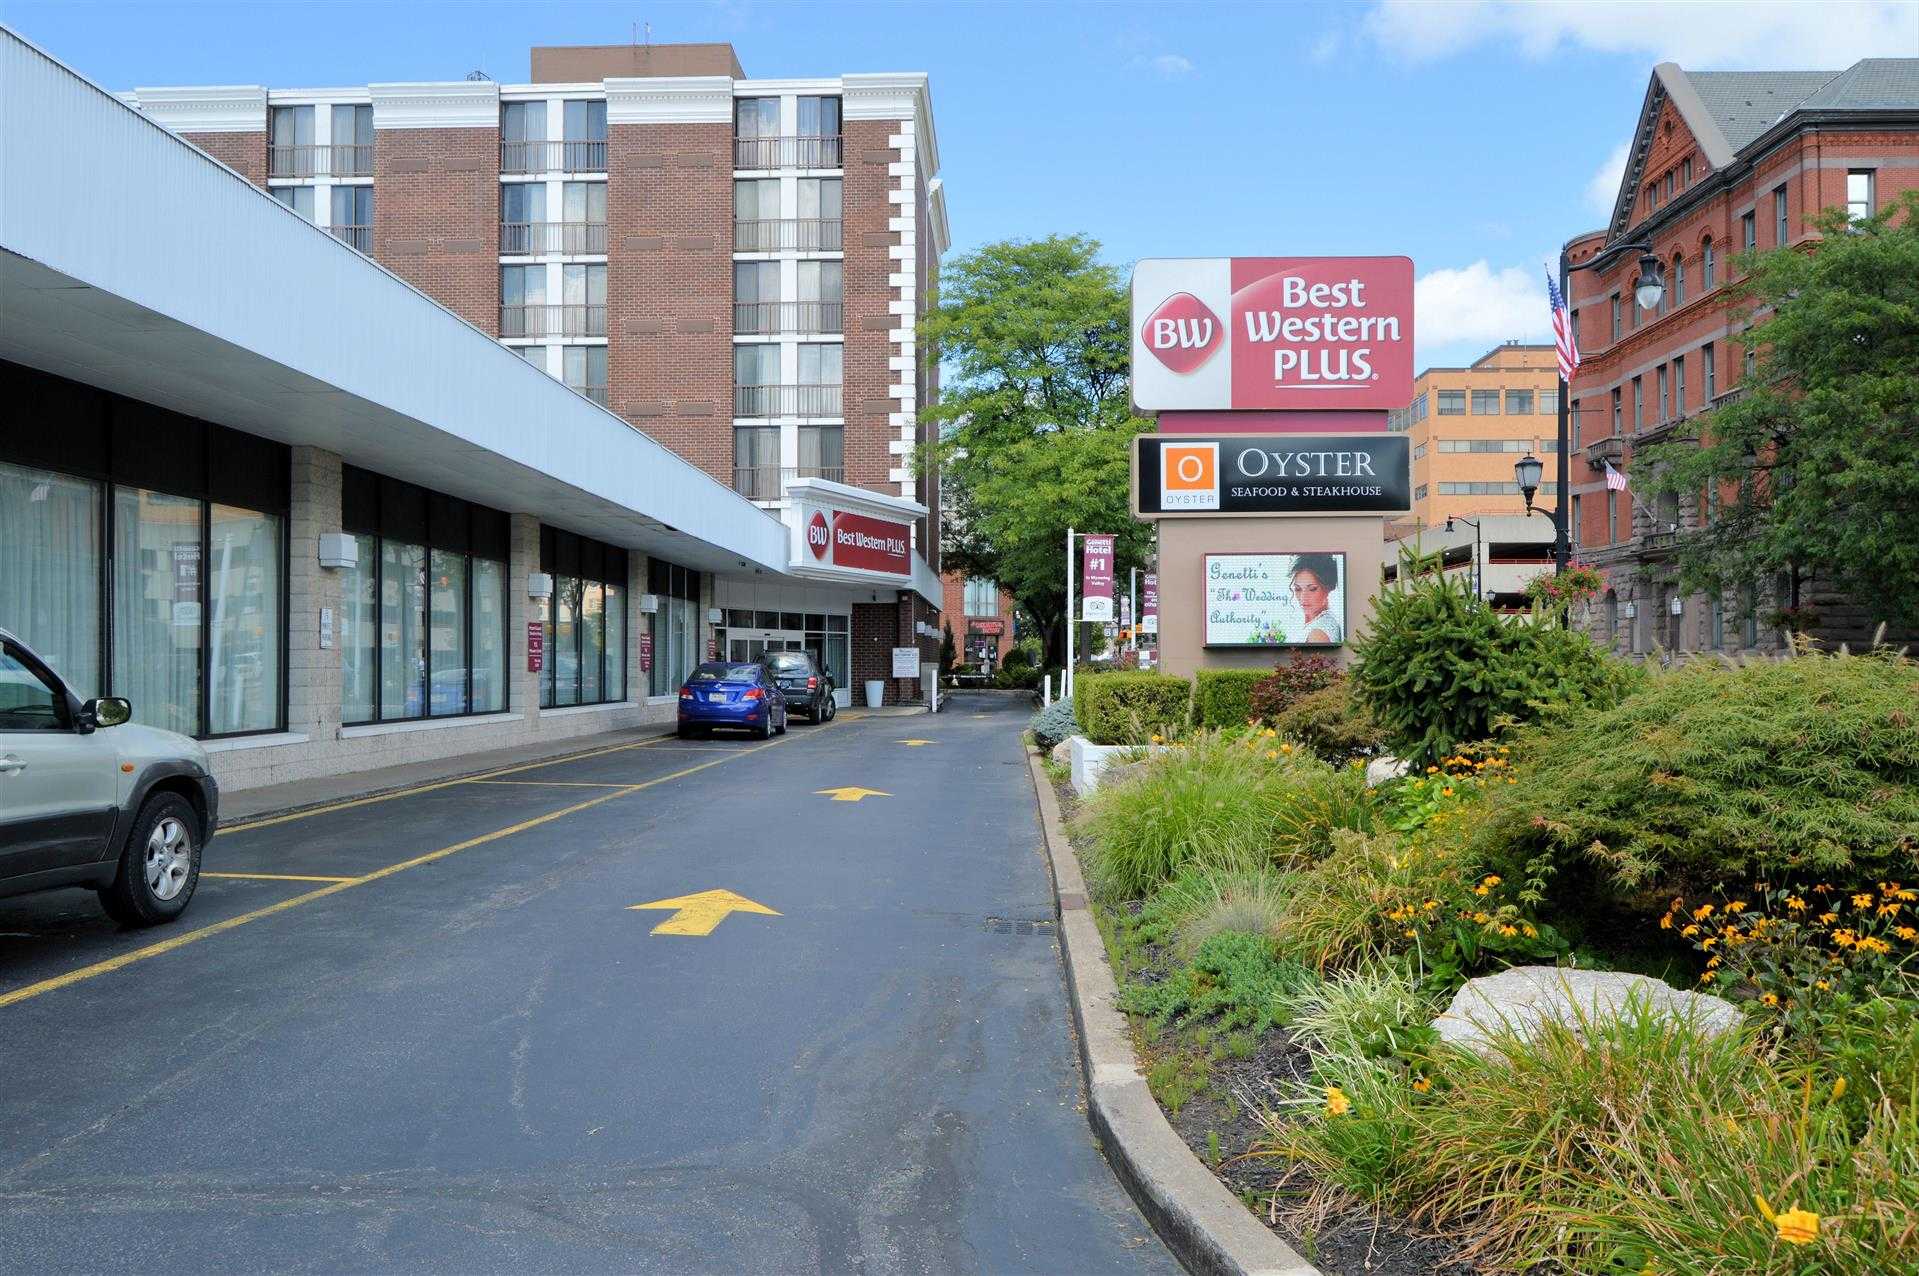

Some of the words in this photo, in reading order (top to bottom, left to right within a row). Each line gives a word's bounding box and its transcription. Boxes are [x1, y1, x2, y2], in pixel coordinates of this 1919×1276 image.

[1282, 276, 1366, 308] Best
[1153, 318, 1213, 349] BW
[1244, 311, 1401, 343] Western
[1236, 447, 1376, 478] OYSTER
[1165, 494, 1216, 505] OYSTER
[1230, 486, 1287, 498] SEAFOOD
[1290, 486, 1300, 498] &
[1302, 485, 1383, 497] STEAKHOUSE
[809, 525, 828, 547] BW
[837, 528, 855, 545] Best
[856, 532, 886, 552] Western
[887, 538, 906, 554] PLUS
[1086, 546, 1111, 554] Hotel
[1089, 558, 1105, 570] #1
[1210, 562, 1269, 580] Genetti's
[1242, 587, 1290, 607] Wedding
